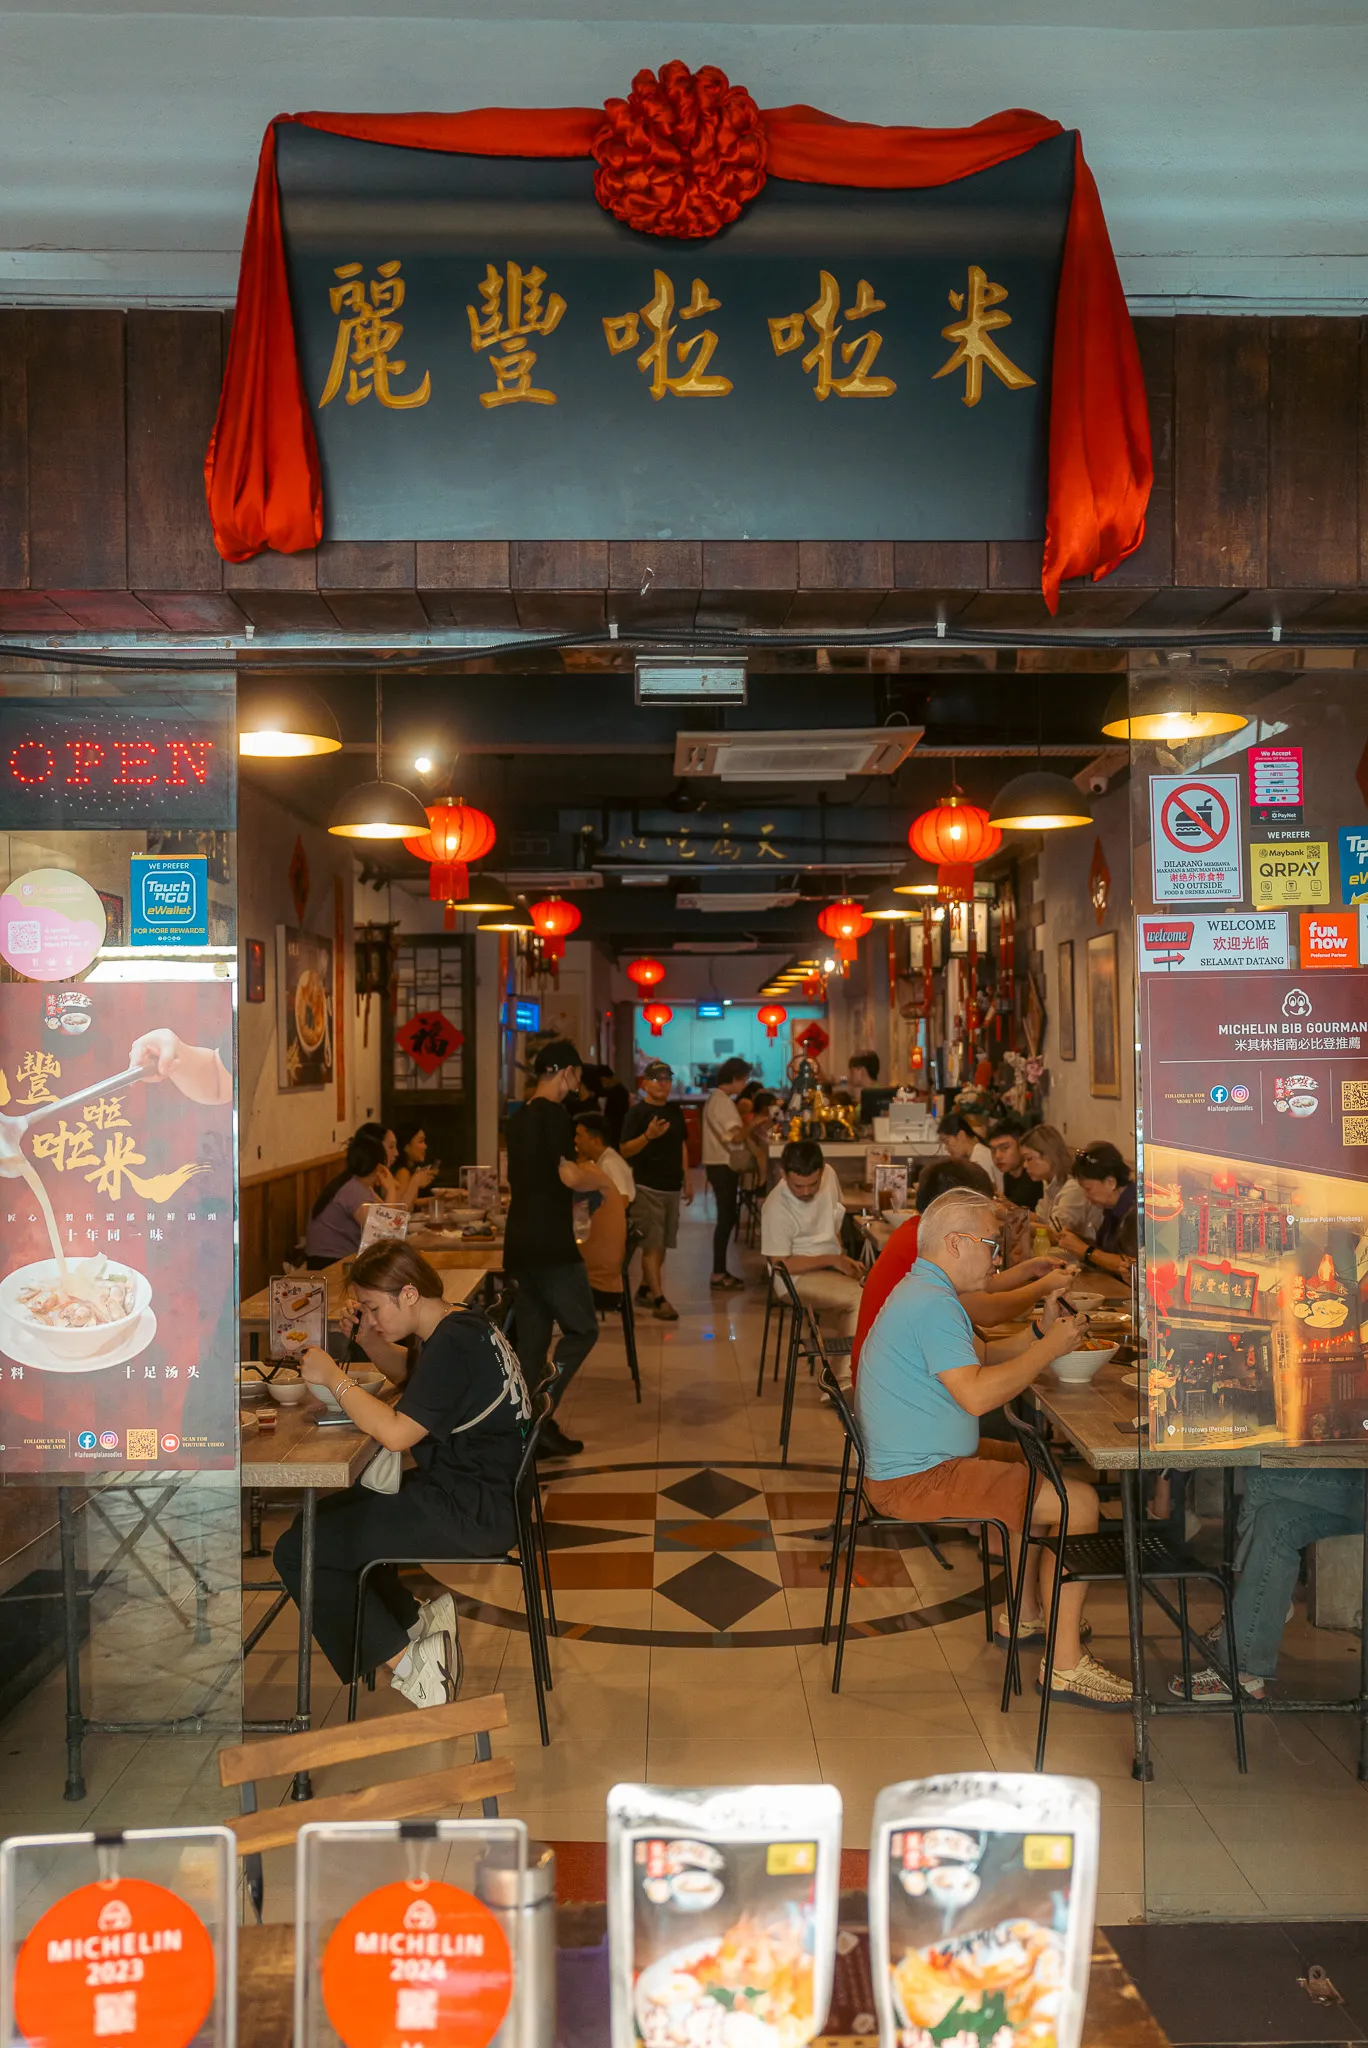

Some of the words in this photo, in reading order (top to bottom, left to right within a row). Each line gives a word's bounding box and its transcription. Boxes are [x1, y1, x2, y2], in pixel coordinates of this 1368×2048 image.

[318, 260, 1037, 409] 麗豐啦啦米
[8, 741, 214, 785] OPEN
[1269, 849, 1304, 857] Maybank
[1169, 872, 1225, 882] 谢绝外带食物
[1259, 862, 1320, 877] QRPAY
[147, 881, 190, 892] Touch
[147, 906, 192, 915] eWallet
[1207, 920, 1276, 931] WELCOME
[1147, 928, 1188, 943] welcome
[1212, 935, 1270, 951] 欢迎光临
[1200, 958, 1245, 966] SELAMAT
[1246, 957, 1284, 965] DATANG
[1218, 1023, 1278, 1035] MICHELIN
[1281, 1022, 1302, 1034] BIB
[1306, 1021, 1368, 1034] GOURMAN
[1234, 1036, 1361, 1051] 米其林指南必比登推薦
[64, 1228, 164, 1242] 十年同一味
[122, 1365, 200, 1379] 十足汤头
[47, 1930, 182, 1963] MICHELIN
[355, 1932, 484, 1957] MICHELIN
[86, 1958, 144, 1987] 2023
[389, 1959, 447, 1983] 2024
